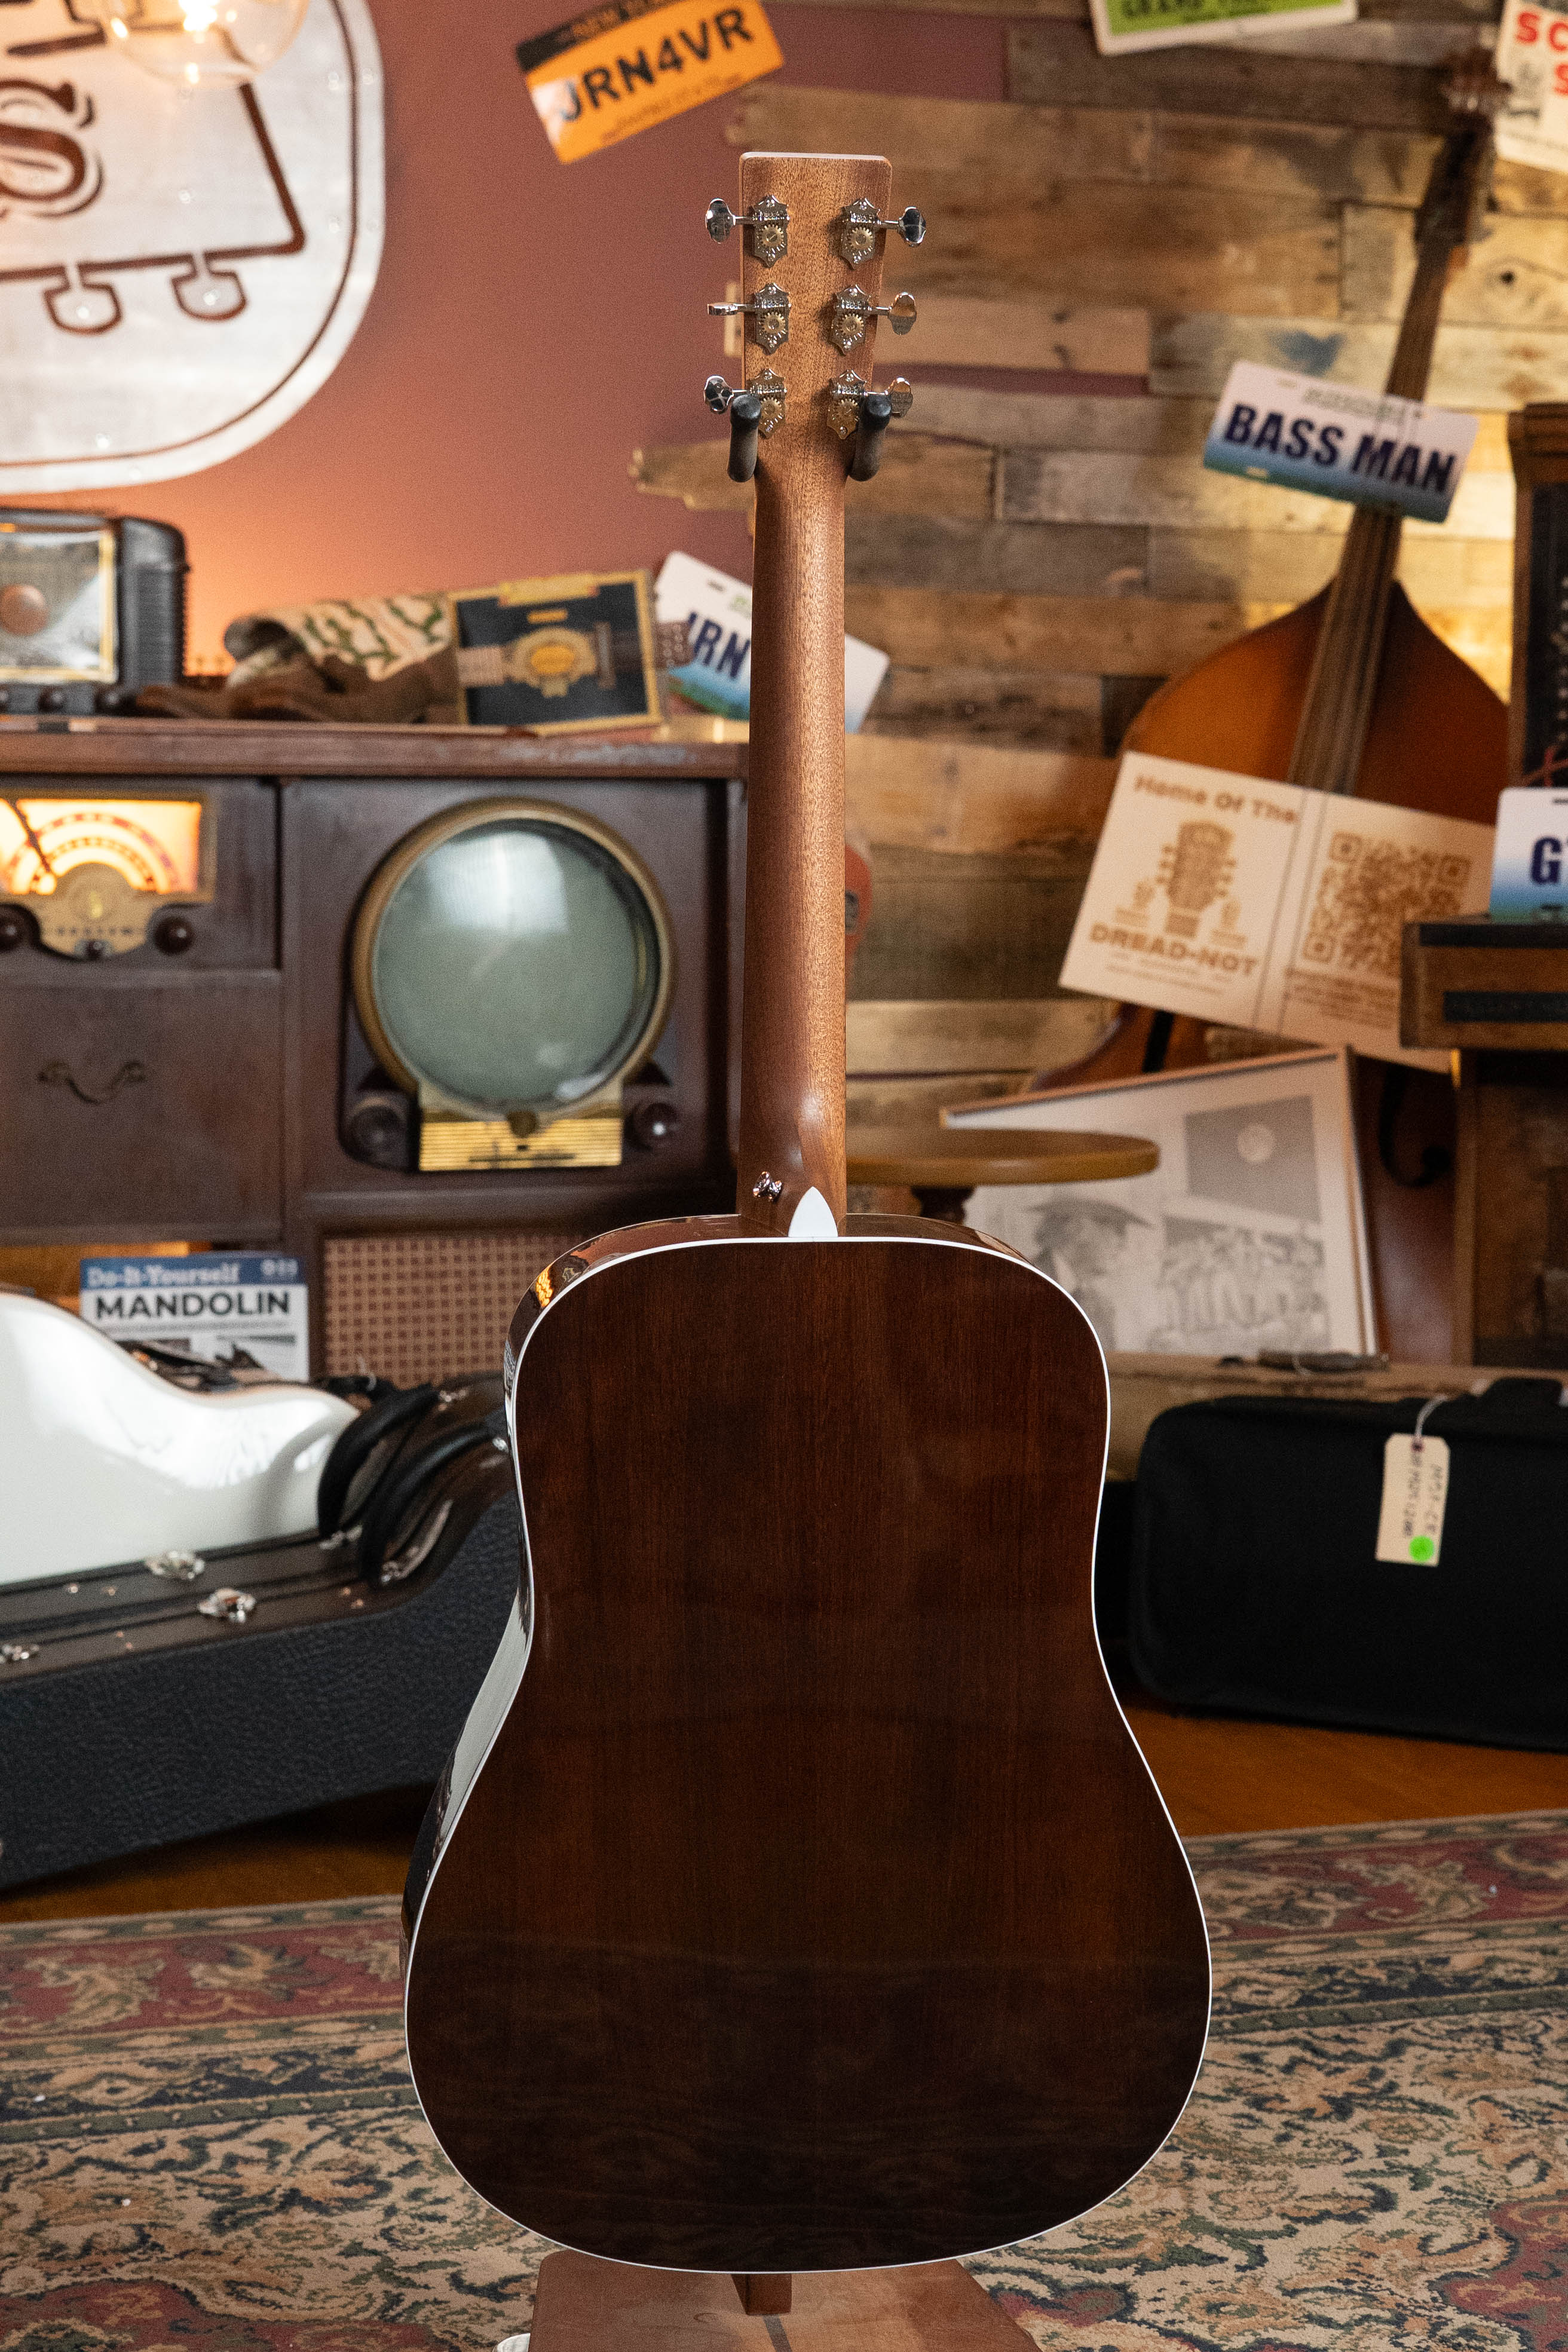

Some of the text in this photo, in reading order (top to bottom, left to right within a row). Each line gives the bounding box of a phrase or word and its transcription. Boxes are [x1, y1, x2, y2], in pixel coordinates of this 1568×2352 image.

[561, 7, 754, 121] JRN4VR
[1224, 402, 1346, 466] BASS
[1351, 434, 1456, 493] MAN
[1135, 776, 1298, 824] Home Of The
[1090, 922, 1257, 975] DREAD-NOT
[95, 1290, 290, 1319] MANDOLIN
